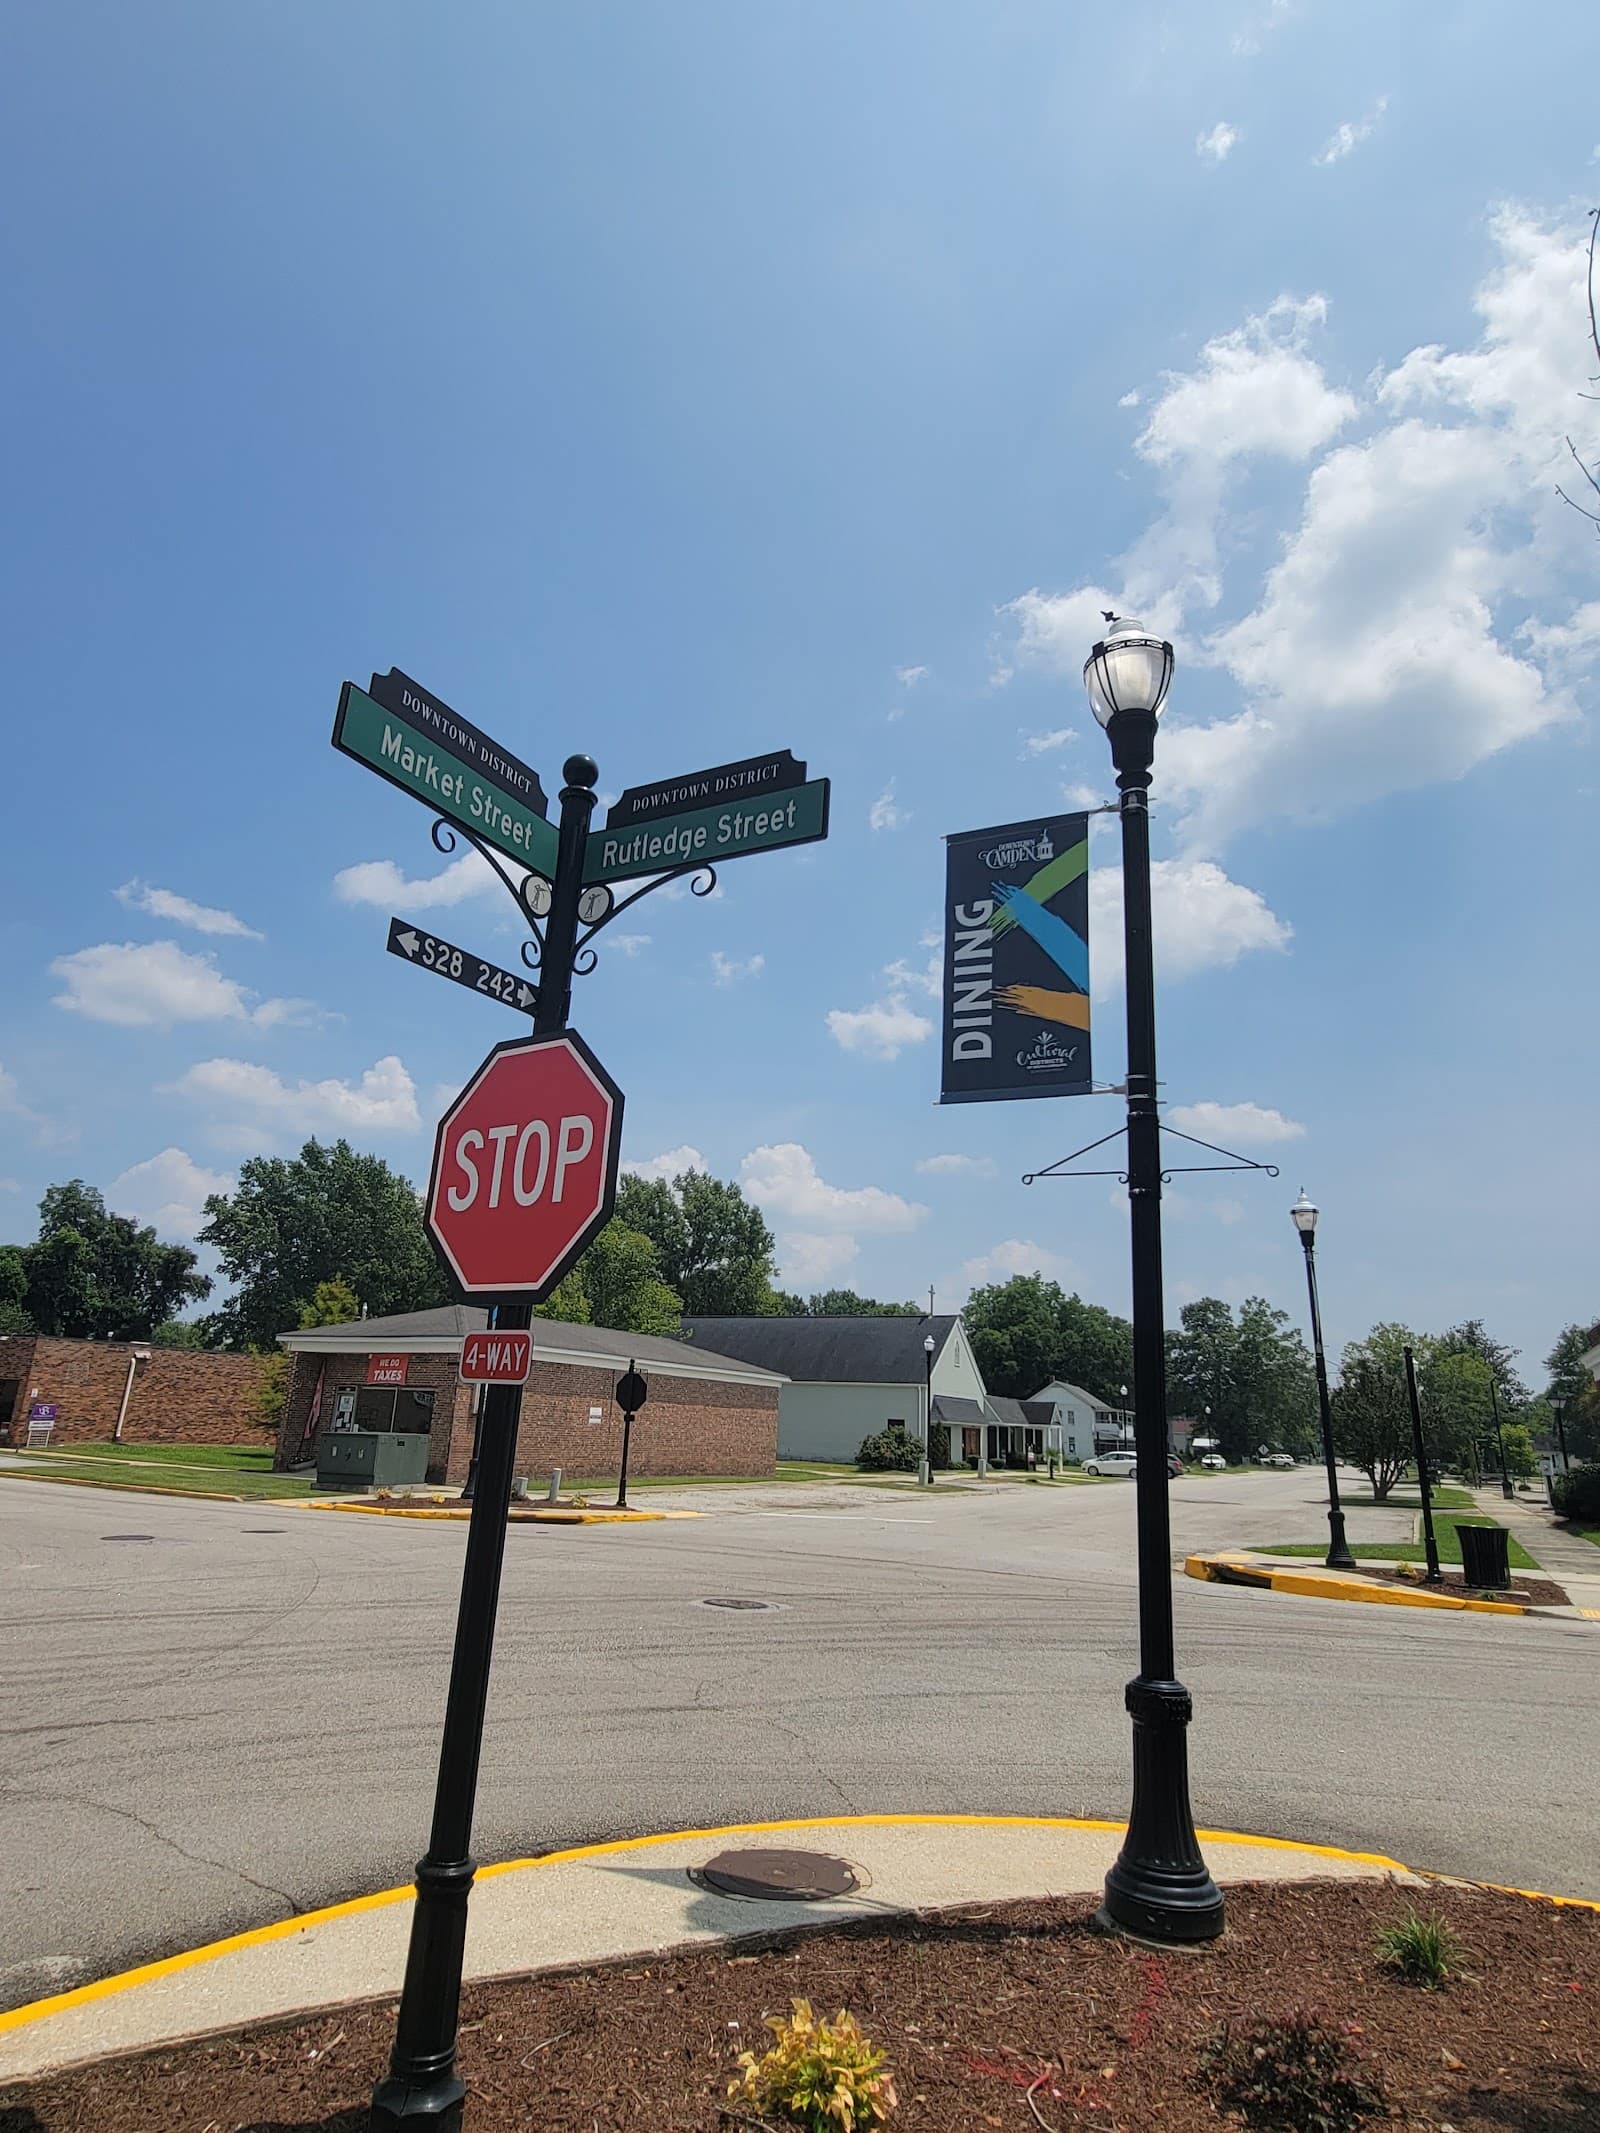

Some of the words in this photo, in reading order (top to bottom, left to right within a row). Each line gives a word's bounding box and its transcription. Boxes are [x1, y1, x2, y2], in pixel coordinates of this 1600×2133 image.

[402, 689, 477, 754] DOWNTOWN
[481, 747, 531, 794] DISTRICT
[381, 725, 464, 805] Market
[470, 785, 533, 851] Street
[632, 781, 709, 812] DOWNTOWN
[715, 763, 780, 793] DISTRICT
[602, 826, 707, 868] Rutledge
[716, 799, 797, 843] Street
[978, 845, 1042, 869] CAMDEN
[422, 938, 463, 978] S28
[476, 964, 515, 1003] 242
[953, 899, 993, 1061] DINING
[447, 1114, 594, 1212] STOP
[373, 1370, 402, 1381] TAXES
[379, 1359, 390, 1367] WE
[390, 1359, 400, 1367] DO
[465, 1342, 526, 1373] 4-WAY
